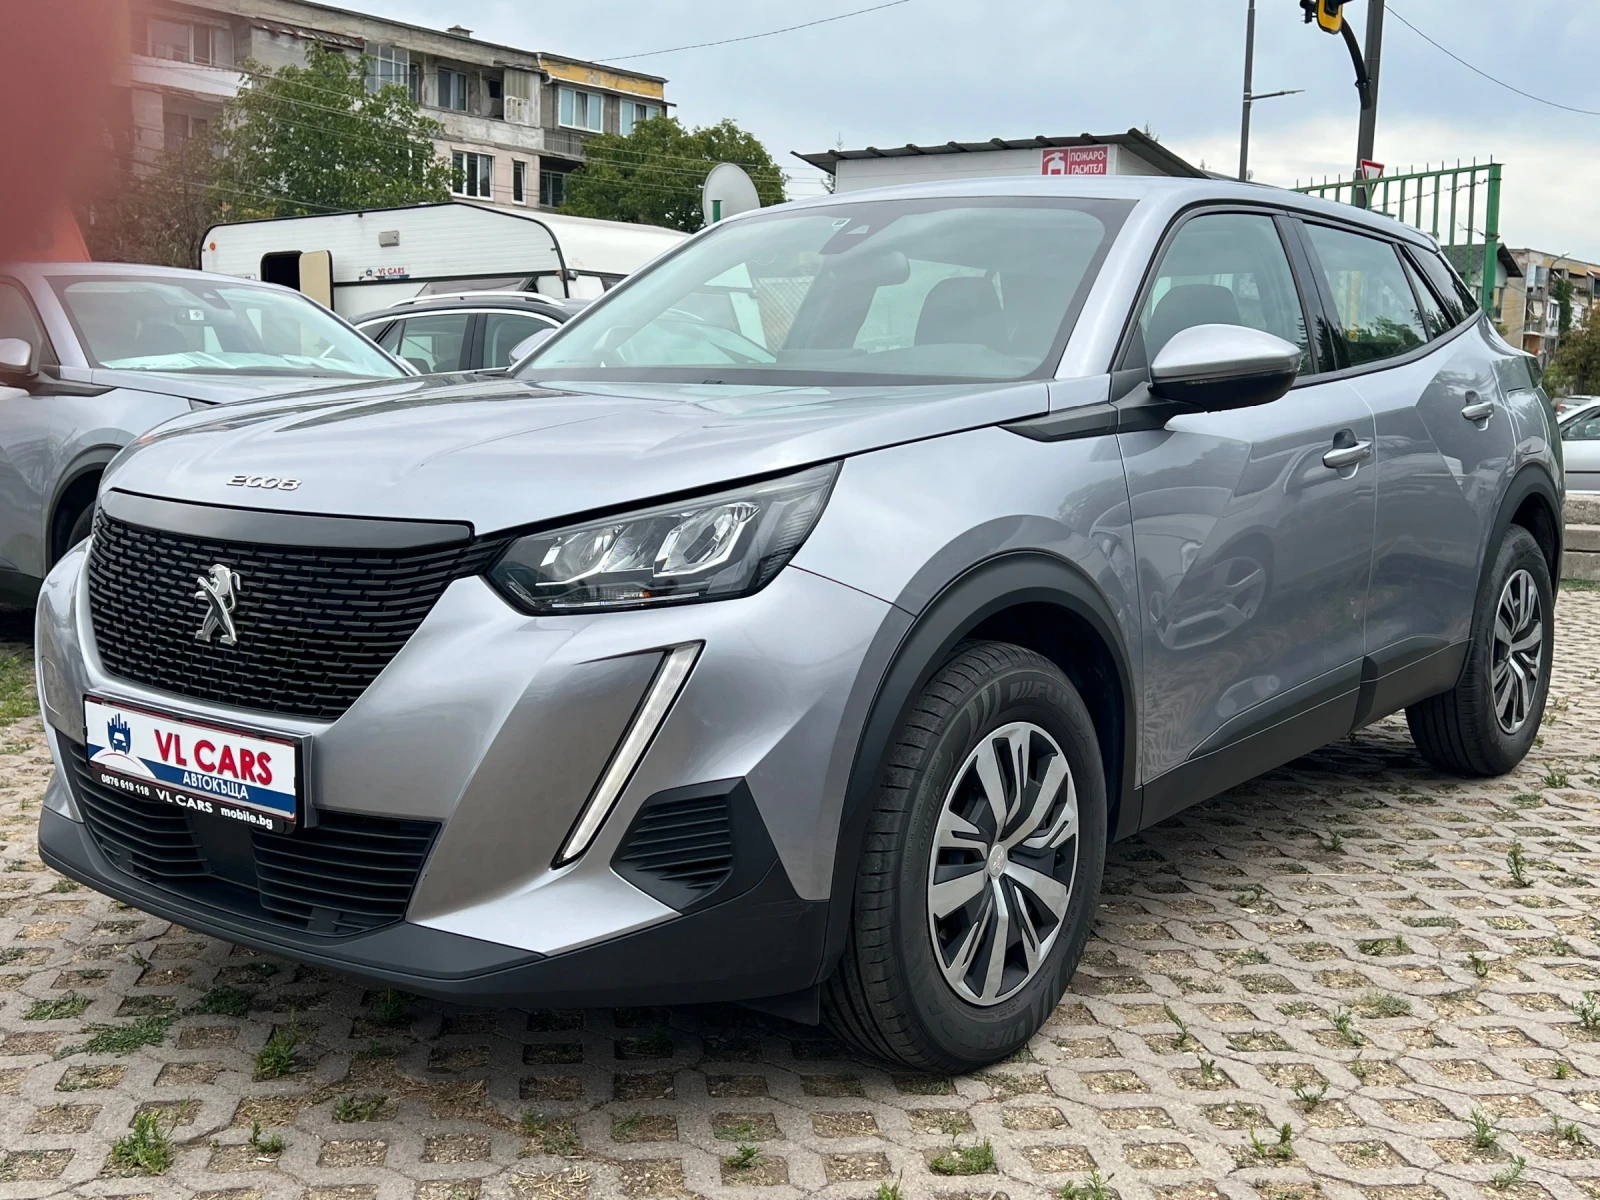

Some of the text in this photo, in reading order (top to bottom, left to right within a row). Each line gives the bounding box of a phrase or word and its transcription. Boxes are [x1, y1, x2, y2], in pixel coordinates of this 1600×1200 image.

[1070, 151, 1106, 161] ПОЖАРО-
[1071, 164, 1103, 175] ГАСИТЕЛ
[226, 475, 302, 491] 2008
[154, 729, 272, 785] VL CARS
[182, 772, 249, 799] АВТОКЪЩА
[101, 773, 273, 830] 0876 619 118 VL CARS mobile.bg
